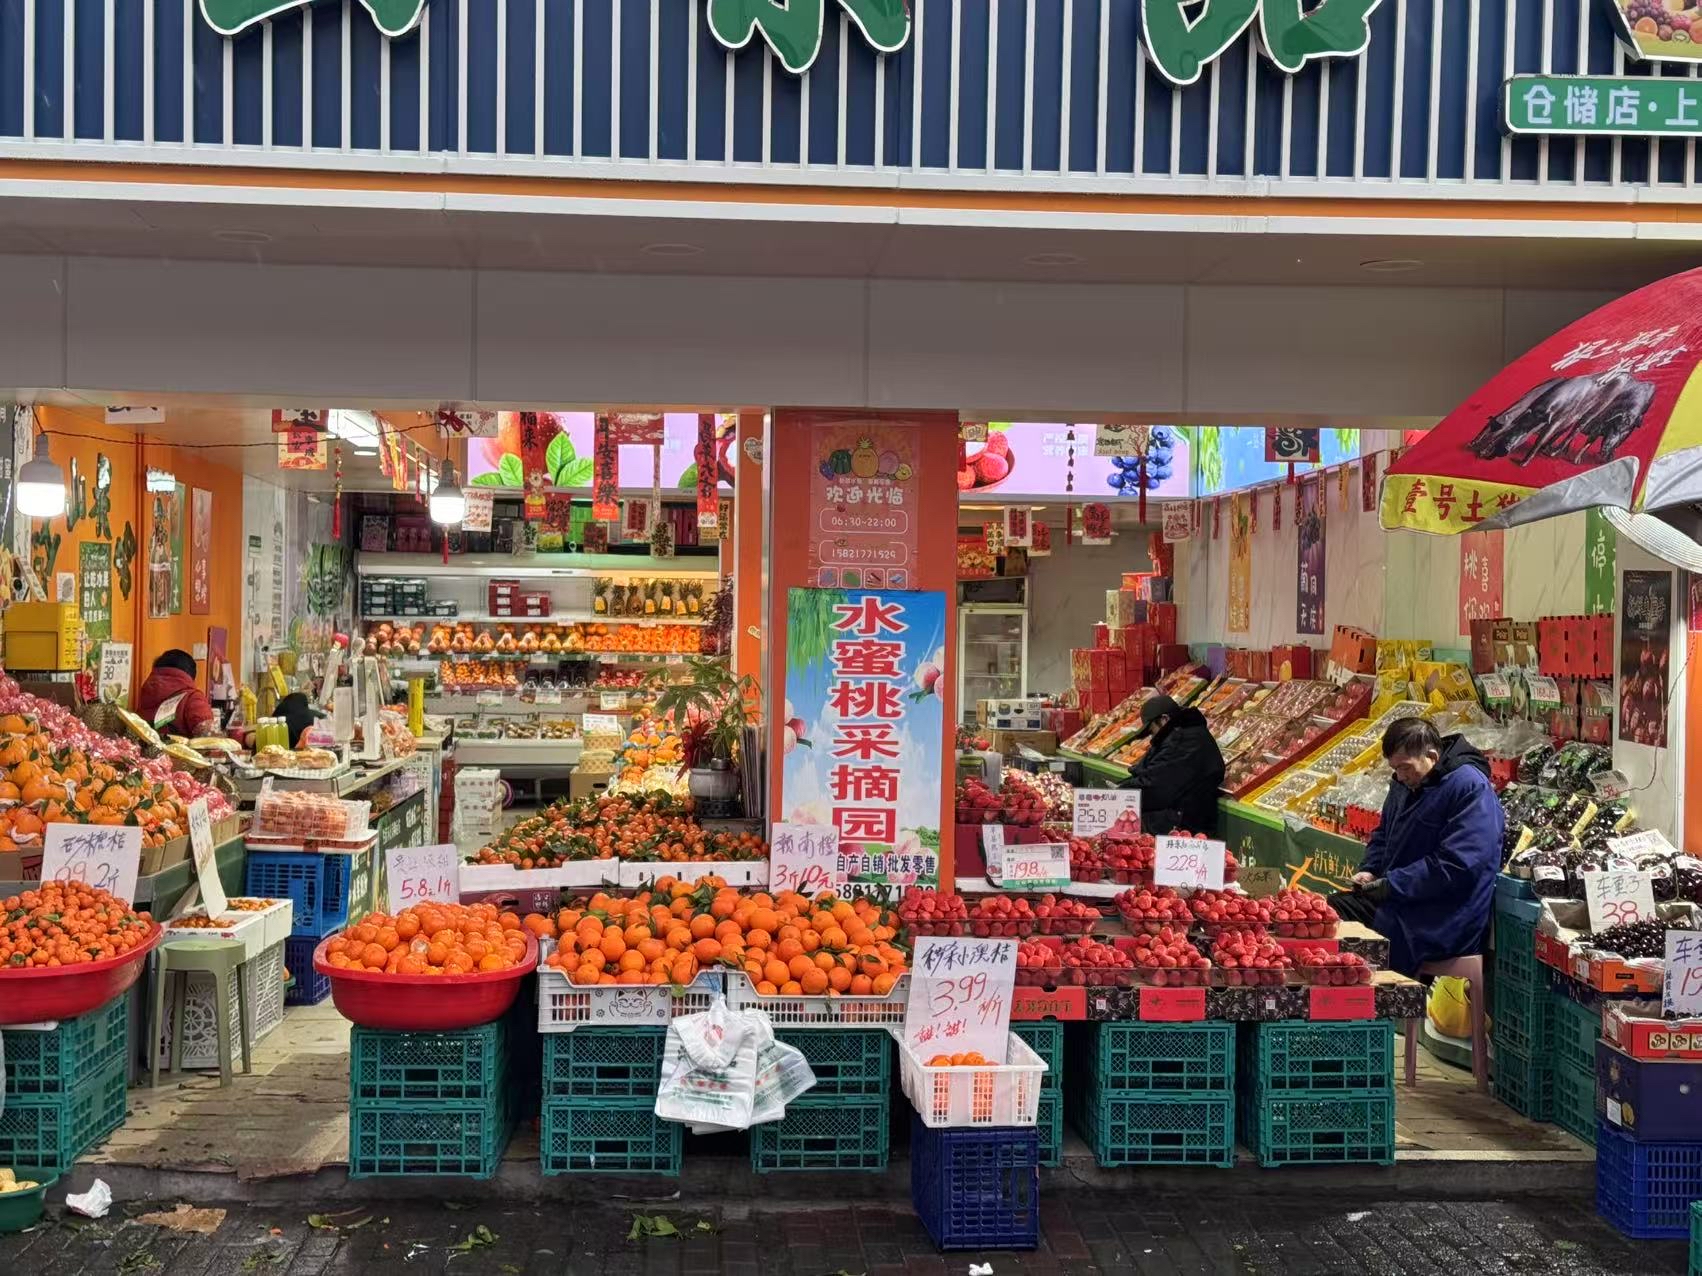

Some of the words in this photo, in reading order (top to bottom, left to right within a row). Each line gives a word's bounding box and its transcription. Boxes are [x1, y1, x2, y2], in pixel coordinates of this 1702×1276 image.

[831, 597, 905, 844] 水蜜桃采摘园
[836, 854, 885, 873] 自产自销
[888, 854, 936, 874] 批发零售
[931, 971, 988, 1018] 3.99
